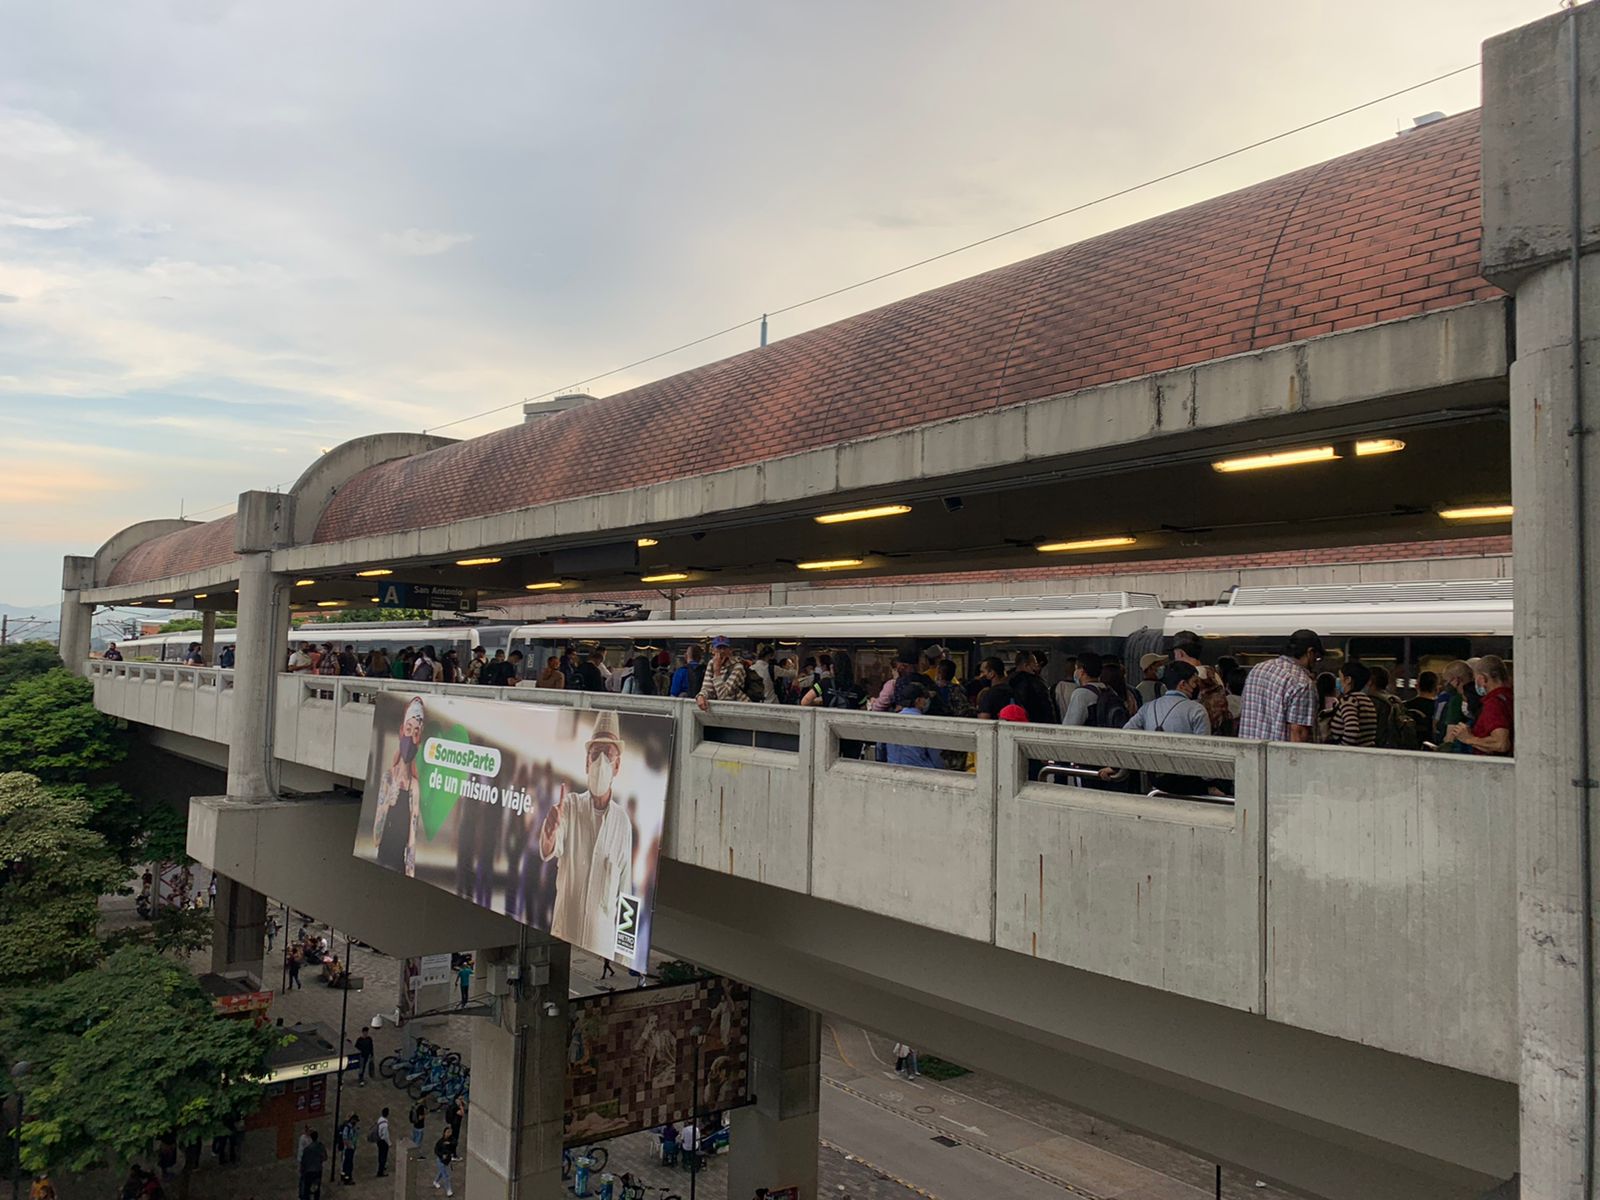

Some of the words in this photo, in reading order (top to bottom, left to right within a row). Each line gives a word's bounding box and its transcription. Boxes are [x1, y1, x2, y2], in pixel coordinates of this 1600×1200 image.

[384, 586, 399, 604] A
[413, 585, 430, 594] San
[431, 586, 463, 596] Antonio
[428, 743, 495, 772] #SomosParte
[429, 768, 442, 790] de
[444, 776, 458, 794] un
[459, 776, 499, 805] mismo
[501, 785, 534, 816] viaje.
[618, 933, 634, 944] METRO
[302, 1061, 329, 1075] gana
